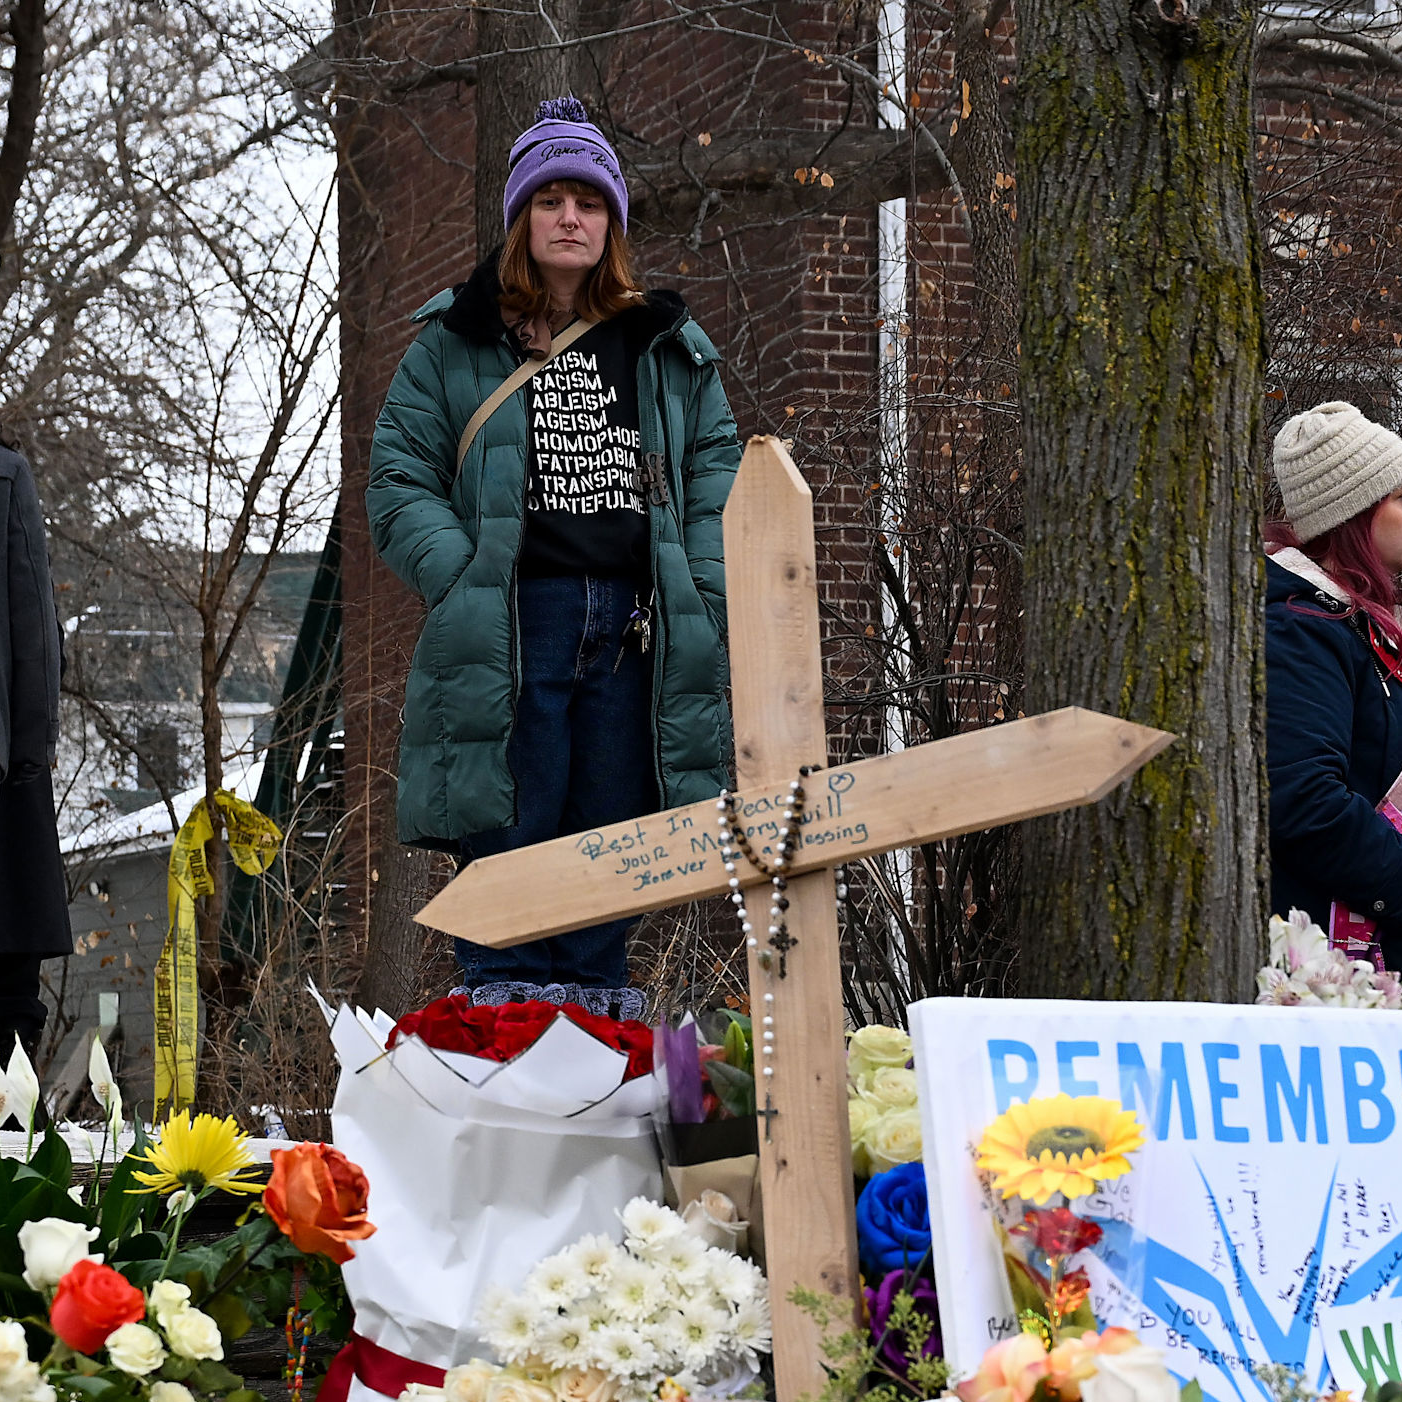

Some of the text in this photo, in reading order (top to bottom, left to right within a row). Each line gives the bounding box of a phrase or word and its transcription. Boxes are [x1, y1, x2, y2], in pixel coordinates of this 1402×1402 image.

[541, 351, 598, 371] XISM
[533, 371, 603, 391] RACISM
[533, 386, 617, 411] ABLEISM
[534, 410, 607, 431] AGEISM
[537, 447, 637, 473] FATPHOBIA
[576, 794, 788, 861] Rest In Peac
[799, 823, 868, 849] lessing
[1165, 1302, 1211, 1329] YOU
[1166, 1327, 1190, 1349] BE
